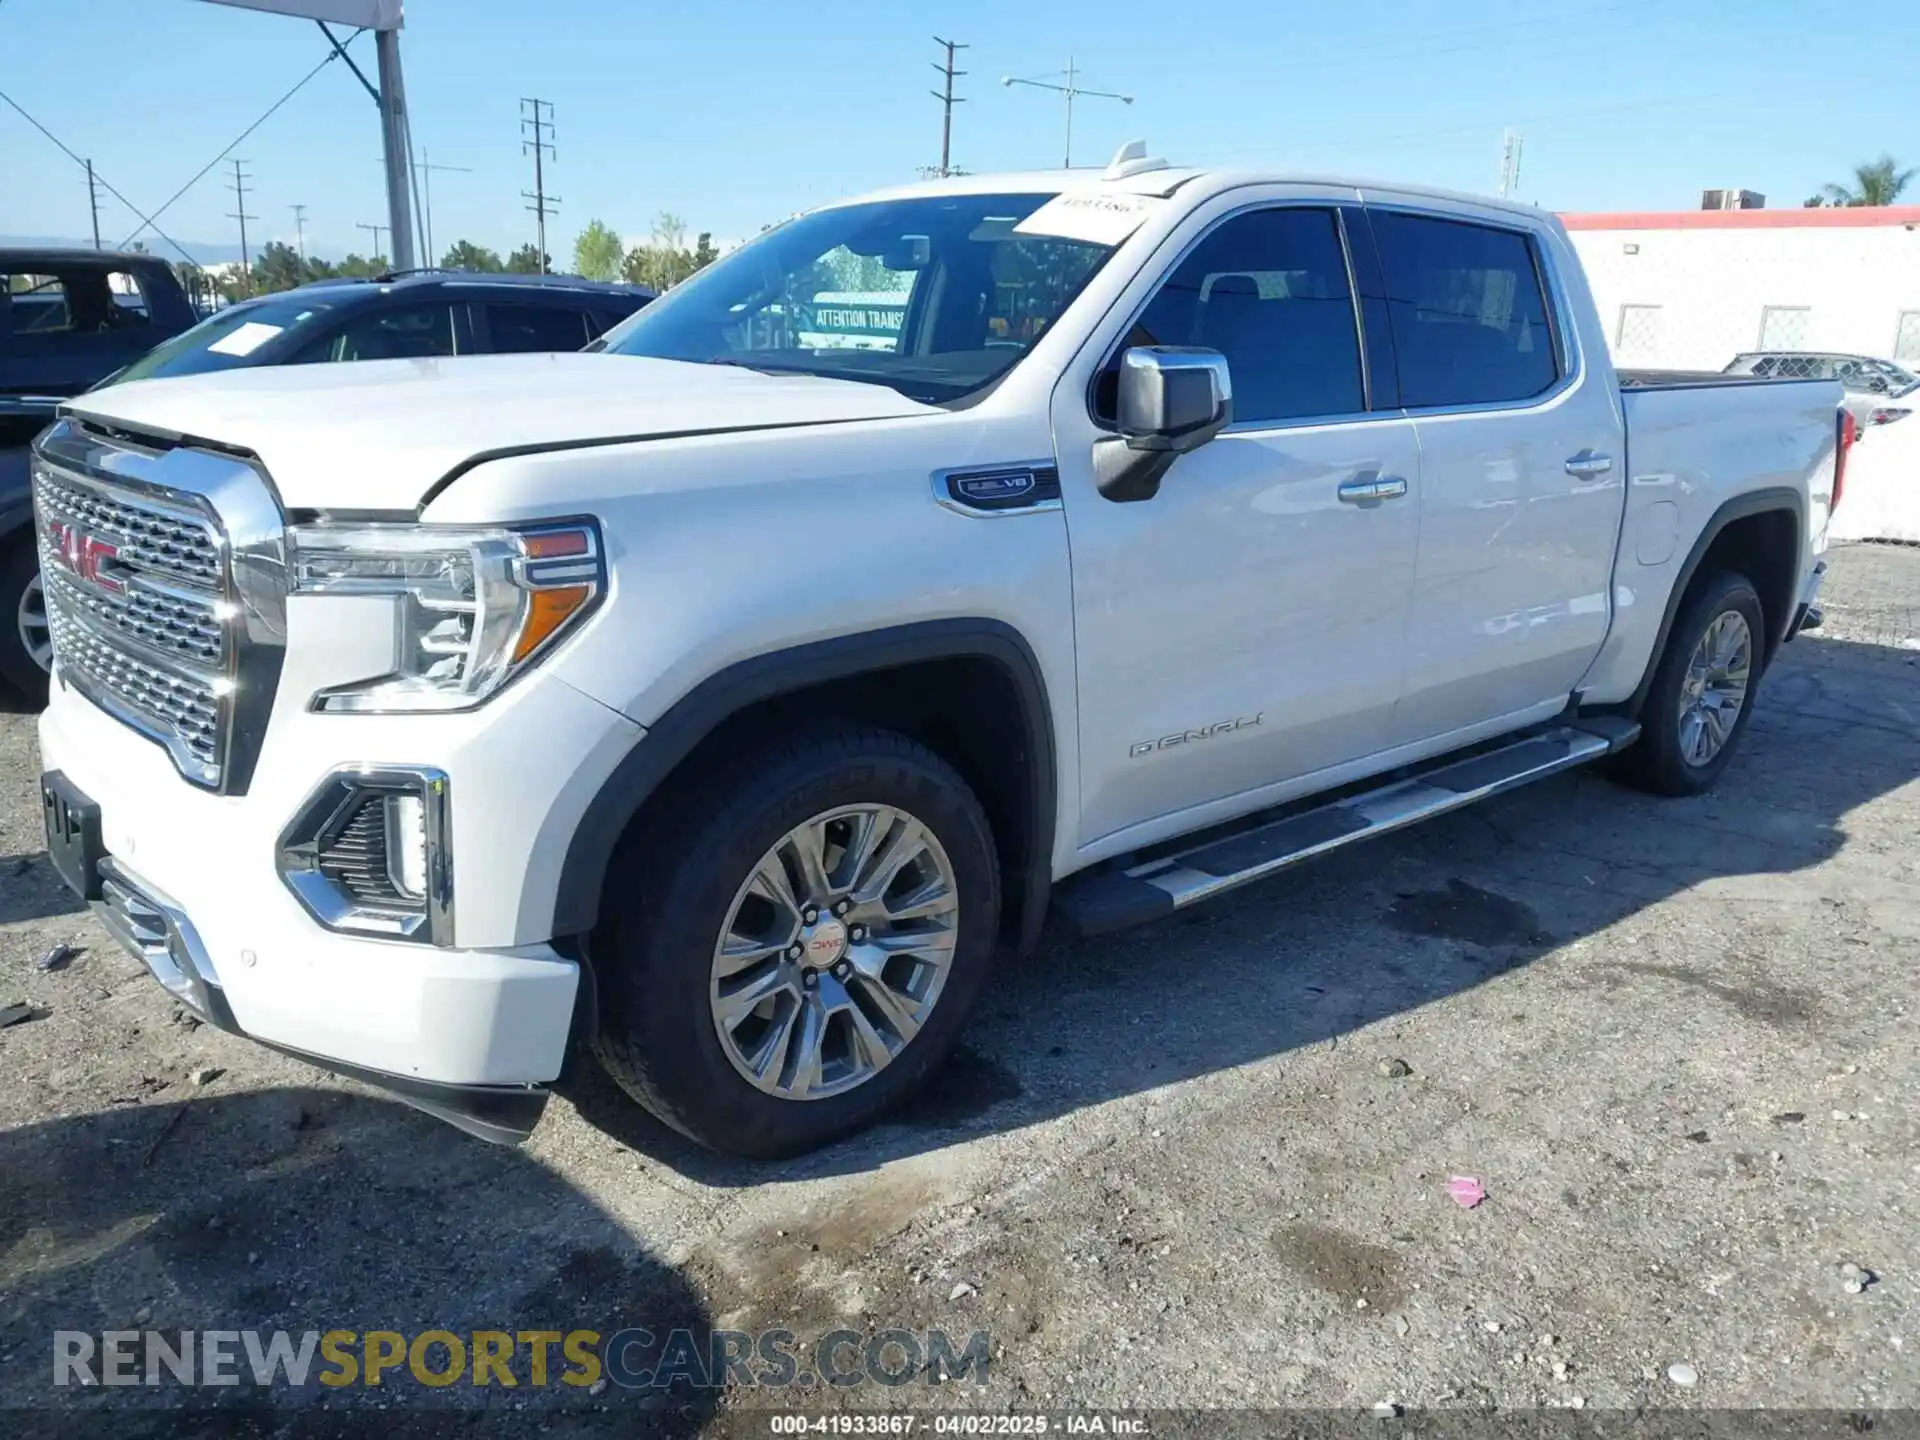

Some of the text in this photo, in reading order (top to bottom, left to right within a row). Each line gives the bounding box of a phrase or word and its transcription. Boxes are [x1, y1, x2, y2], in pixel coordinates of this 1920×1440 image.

[816, 308, 867, 329] ATTENTION
[49, 519, 128, 597] GMC
[1129, 711, 1264, 758] DENALI
